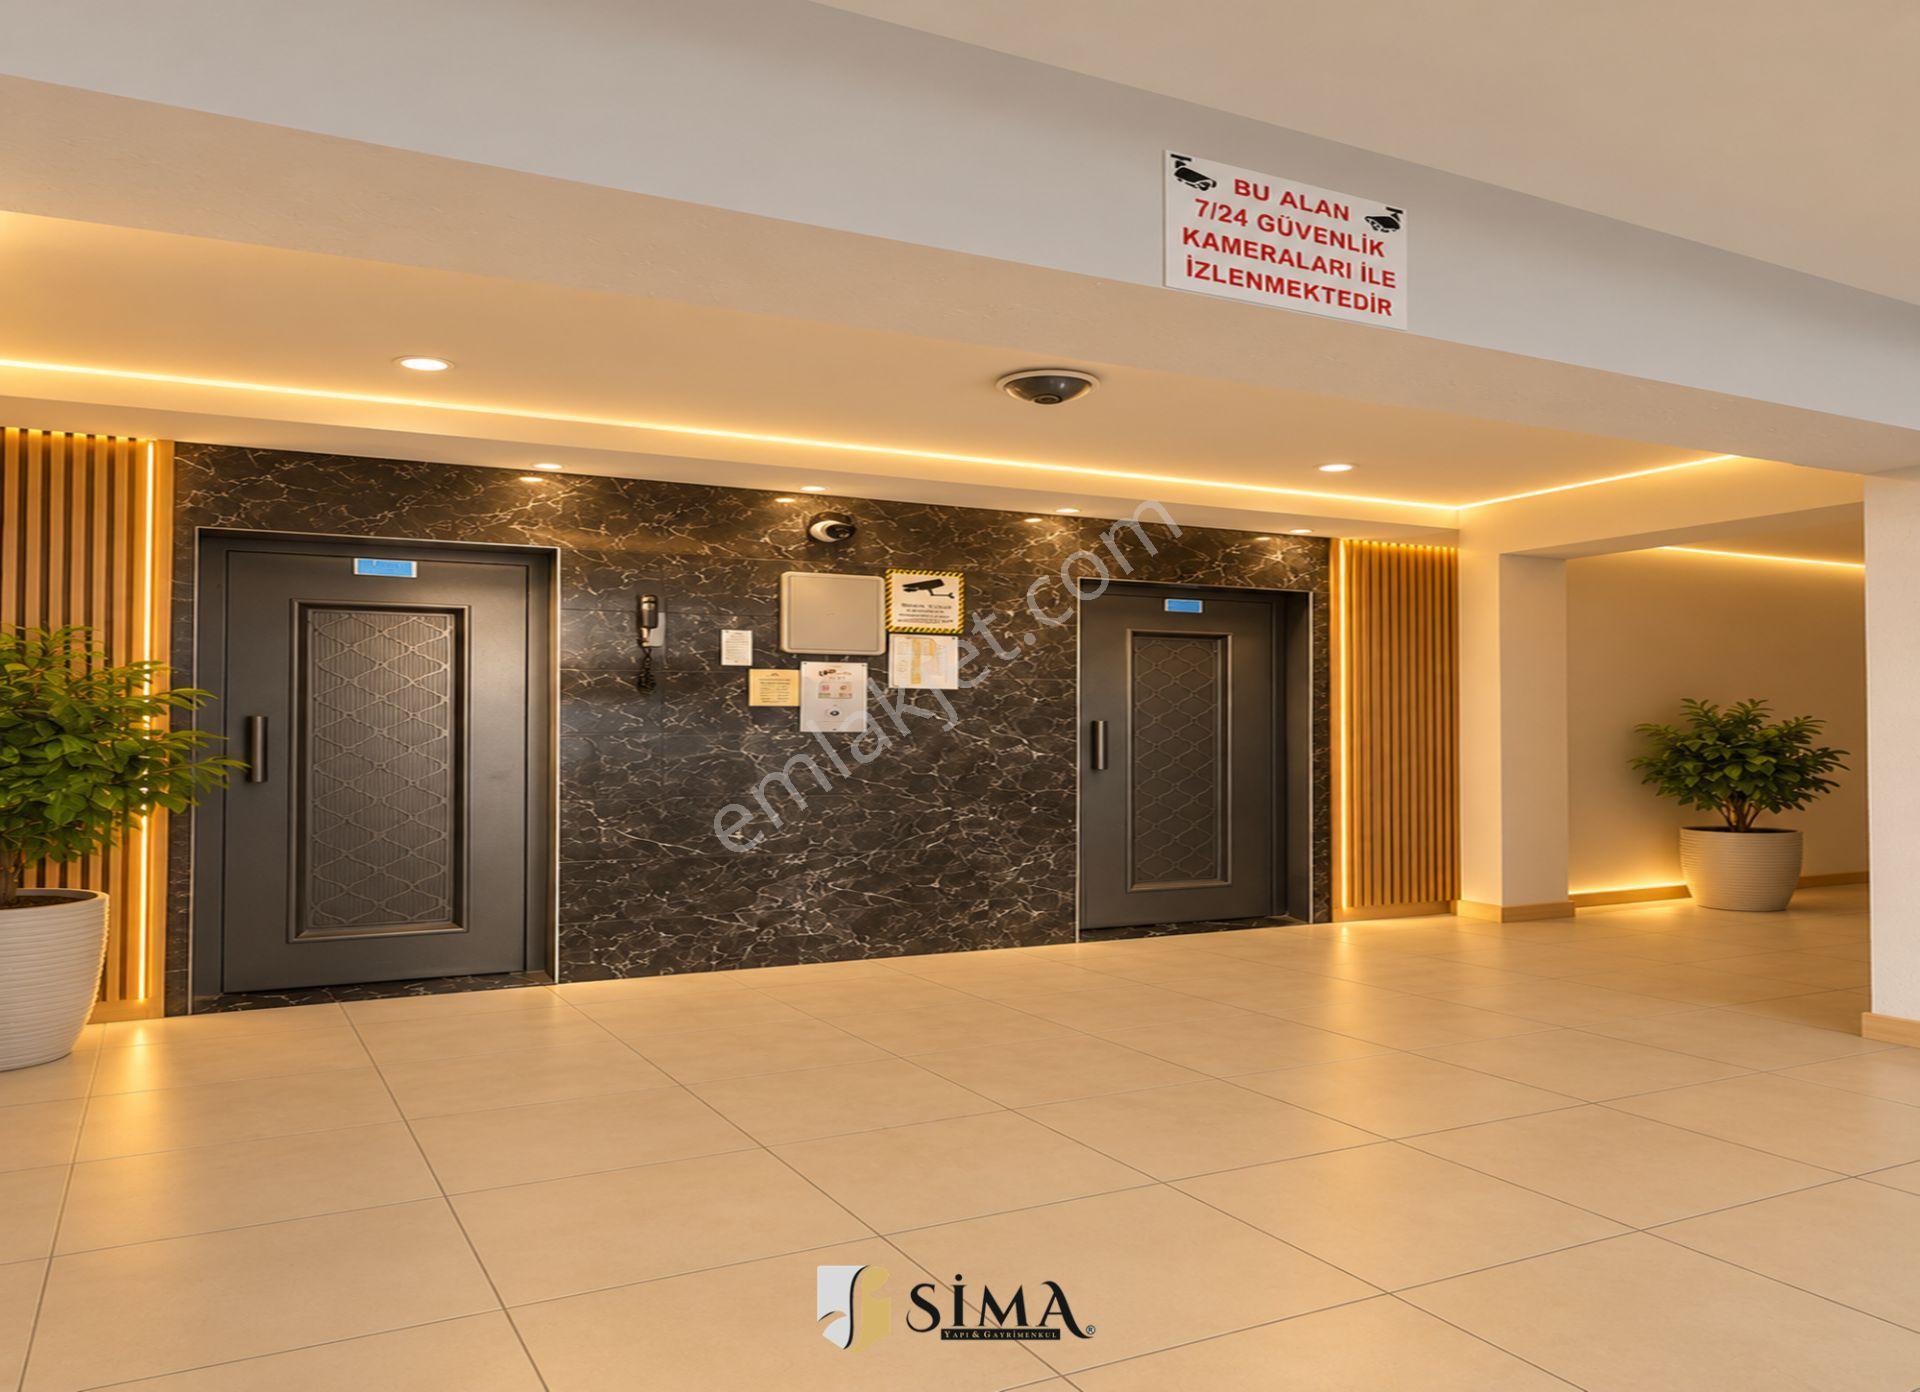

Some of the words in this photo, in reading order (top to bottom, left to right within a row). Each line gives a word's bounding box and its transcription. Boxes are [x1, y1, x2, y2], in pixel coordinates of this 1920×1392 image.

[1195, 198, 1248, 227] 7/24
[1257, 213, 1385, 258] GÜVENLİK
[1234, 178, 1270, 201] BU
[1279, 191, 1349, 221] ALAN
[1183, 227, 1352, 279] KAMERALARI
[1361, 261, 1396, 289] İLE
[1186, 255, 1392, 316] İZLENMEKTEDİR
